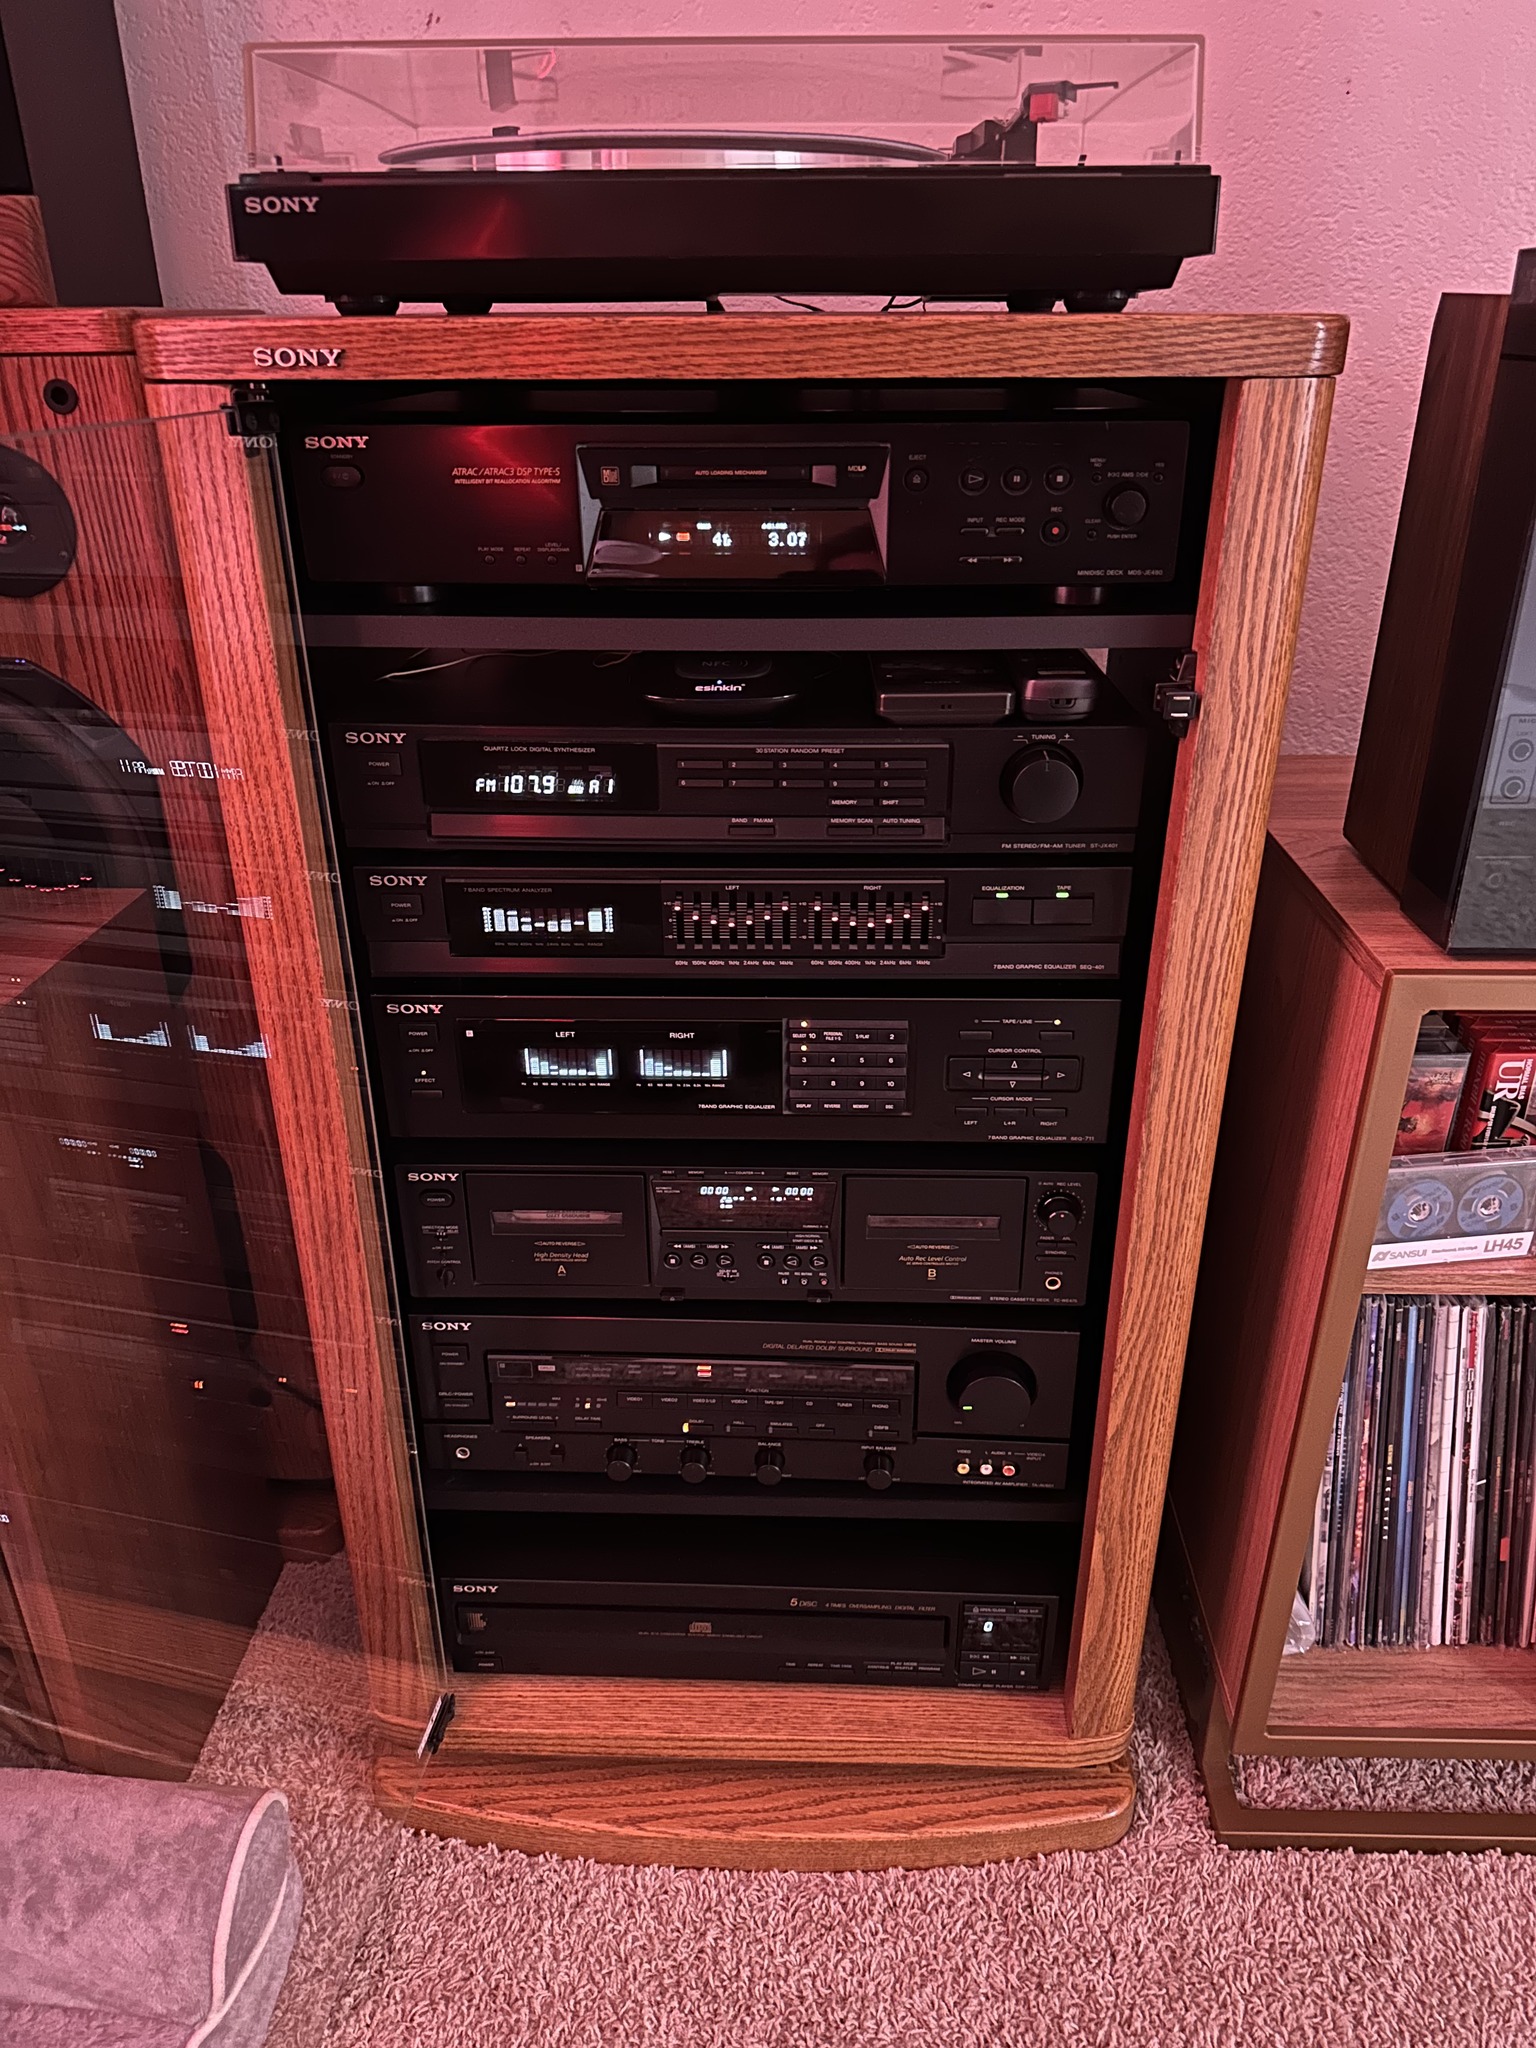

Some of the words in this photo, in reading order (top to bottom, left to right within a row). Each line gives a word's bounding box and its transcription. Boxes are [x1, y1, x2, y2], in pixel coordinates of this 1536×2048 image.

[244, 196, 319, 214] SONY
[253, 347, 342, 368] SONY
[304, 436, 369, 449] SONY
[516, 467, 533, 476] DSP
[533, 467, 561, 476] TYPE-S
[768, 532, 808, 547] 3.07
[694, 683, 743, 692] esinkin
[345, 732, 407, 745] SONY
[475, 777, 497, 793] FM
[369, 875, 428, 887] SONY
[386, 1003, 444, 1015] SONY
[669, 1032, 696, 1040] RIGHT
[1522, 1058, 1534, 1084] NORMAL
[1493, 1059, 1526, 1102] UR
[1517, 1085, 1528, 1100] BIAS
[407, 1172, 460, 1182] SONY
[1483, 1237, 1524, 1253] LH45
[944, 1255, 968, 1263] Control
[1389, 1248, 1428, 1260] SANSUI
[557, 1264, 567, 1274] A
[927, 1268, 937, 1278] B
[421, 1322, 472, 1332] SONY
[786, 1343, 815, 1351] DELAYED
[837, 1345, 873, 1353] SURROUND
[453, 1585, 499, 1593] SONY
